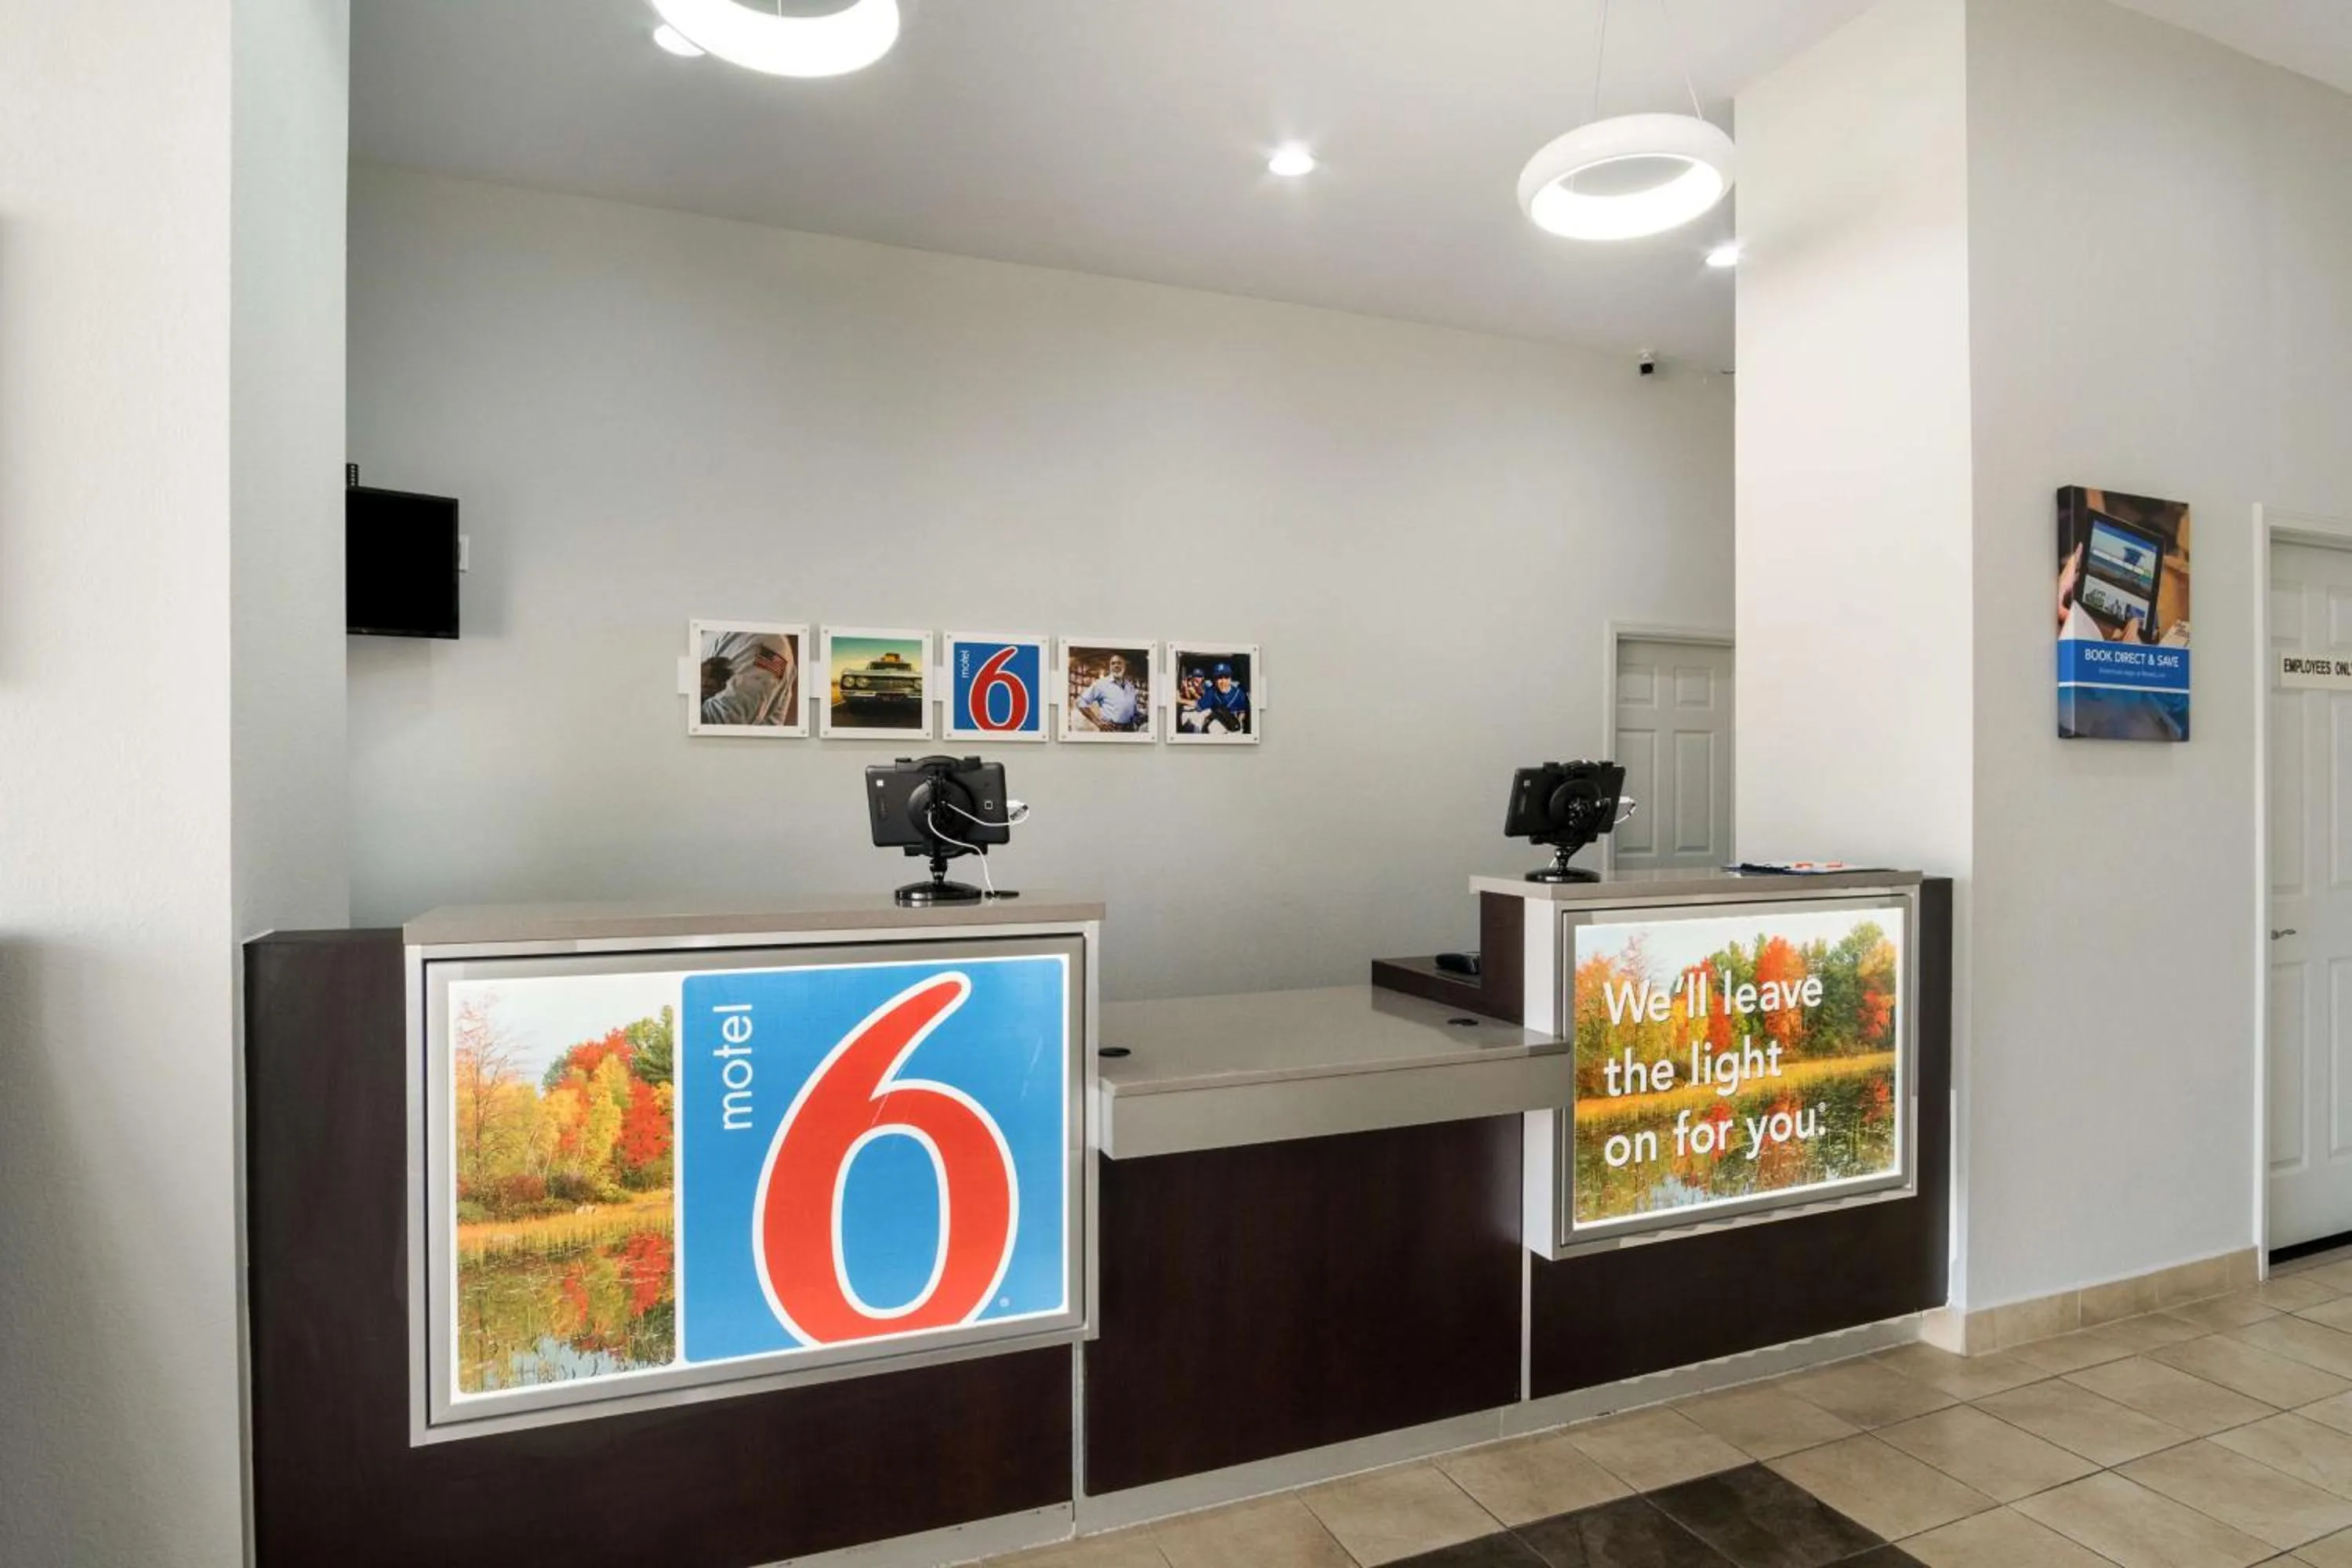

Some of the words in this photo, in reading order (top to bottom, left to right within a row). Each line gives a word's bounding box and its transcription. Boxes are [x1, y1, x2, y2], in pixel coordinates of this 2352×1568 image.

[2085, 648, 2112, 662] BOOK
[2114, 651, 2147, 665] DIRECT
[2147, 654, 2155, 666] &
[2157, 655, 2180, 668] SAVE
[2284, 658, 2331, 675] EMPLOYEES
[2335, 661, 2352, 677] ONL
[960, 650, 970, 678] motel
[968, 646, 1029, 732] 6
[1602, 971, 1707, 1026] We'll
[1723, 970, 1824, 1016] leave
[1603, 1047, 1675, 1098] the
[1690, 1035, 1783, 1097] light
[713, 1004, 753, 1130] motel
[753, 971, 1019, 1347] 6
[1604, 1130, 1657, 1167] on
[1672, 1109, 1735, 1157] for
